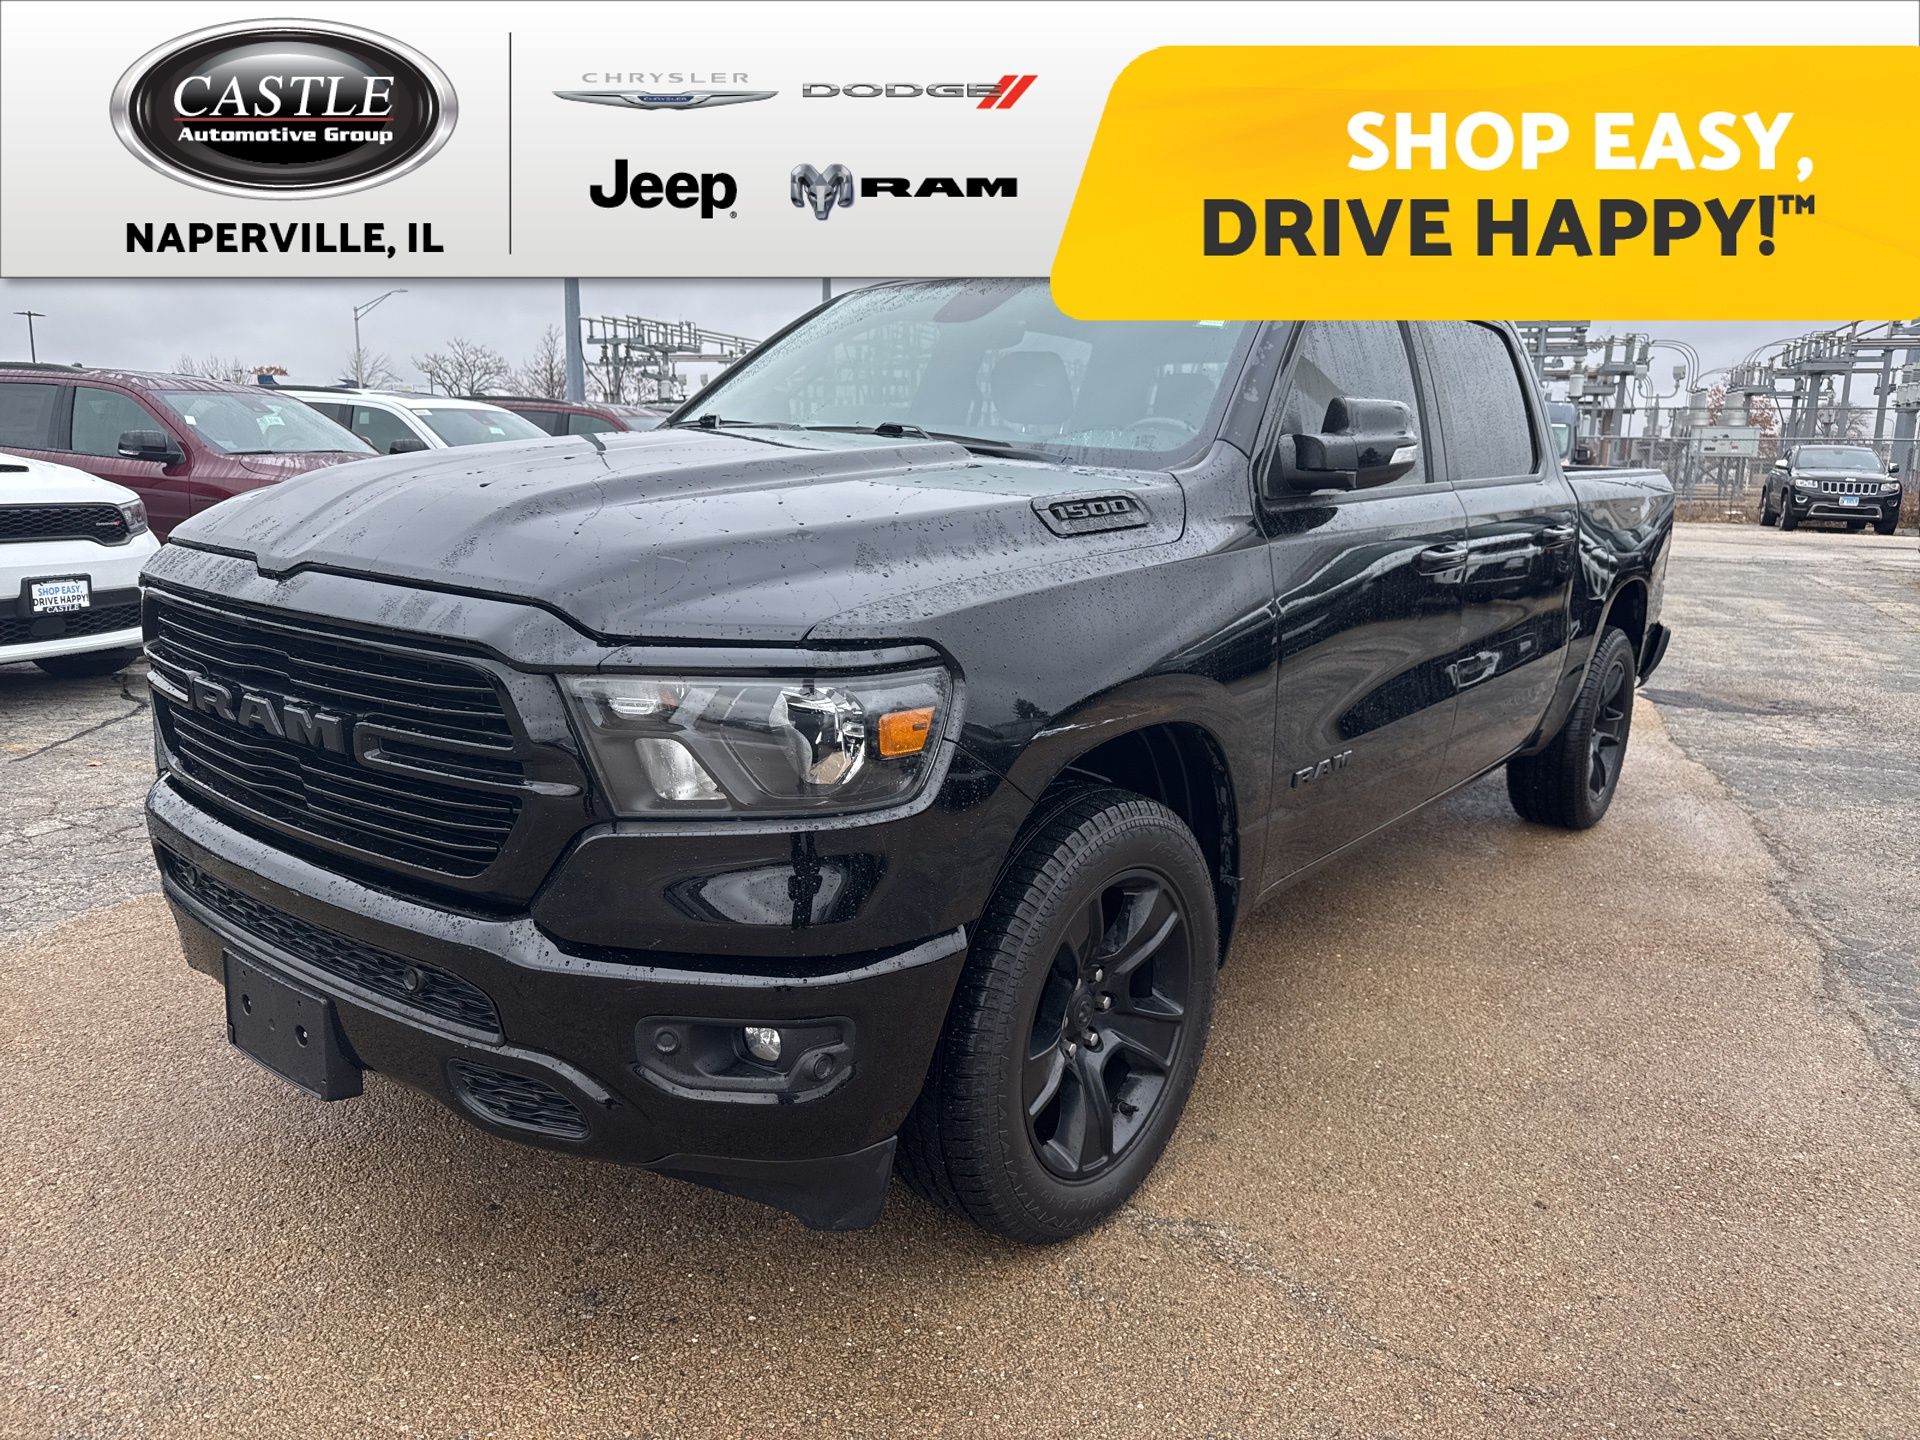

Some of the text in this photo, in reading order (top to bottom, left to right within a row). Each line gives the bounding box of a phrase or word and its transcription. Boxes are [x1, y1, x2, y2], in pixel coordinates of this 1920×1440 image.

[1053, 499, 1131, 520] 1500
[38, 587, 60, 596] SHOP
[33, 596, 58, 606] DRIVE
[46, 604, 80, 613] CASTLE
[193, 676, 346, 754] RAM
[1291, 750, 1353, 788] RAM
